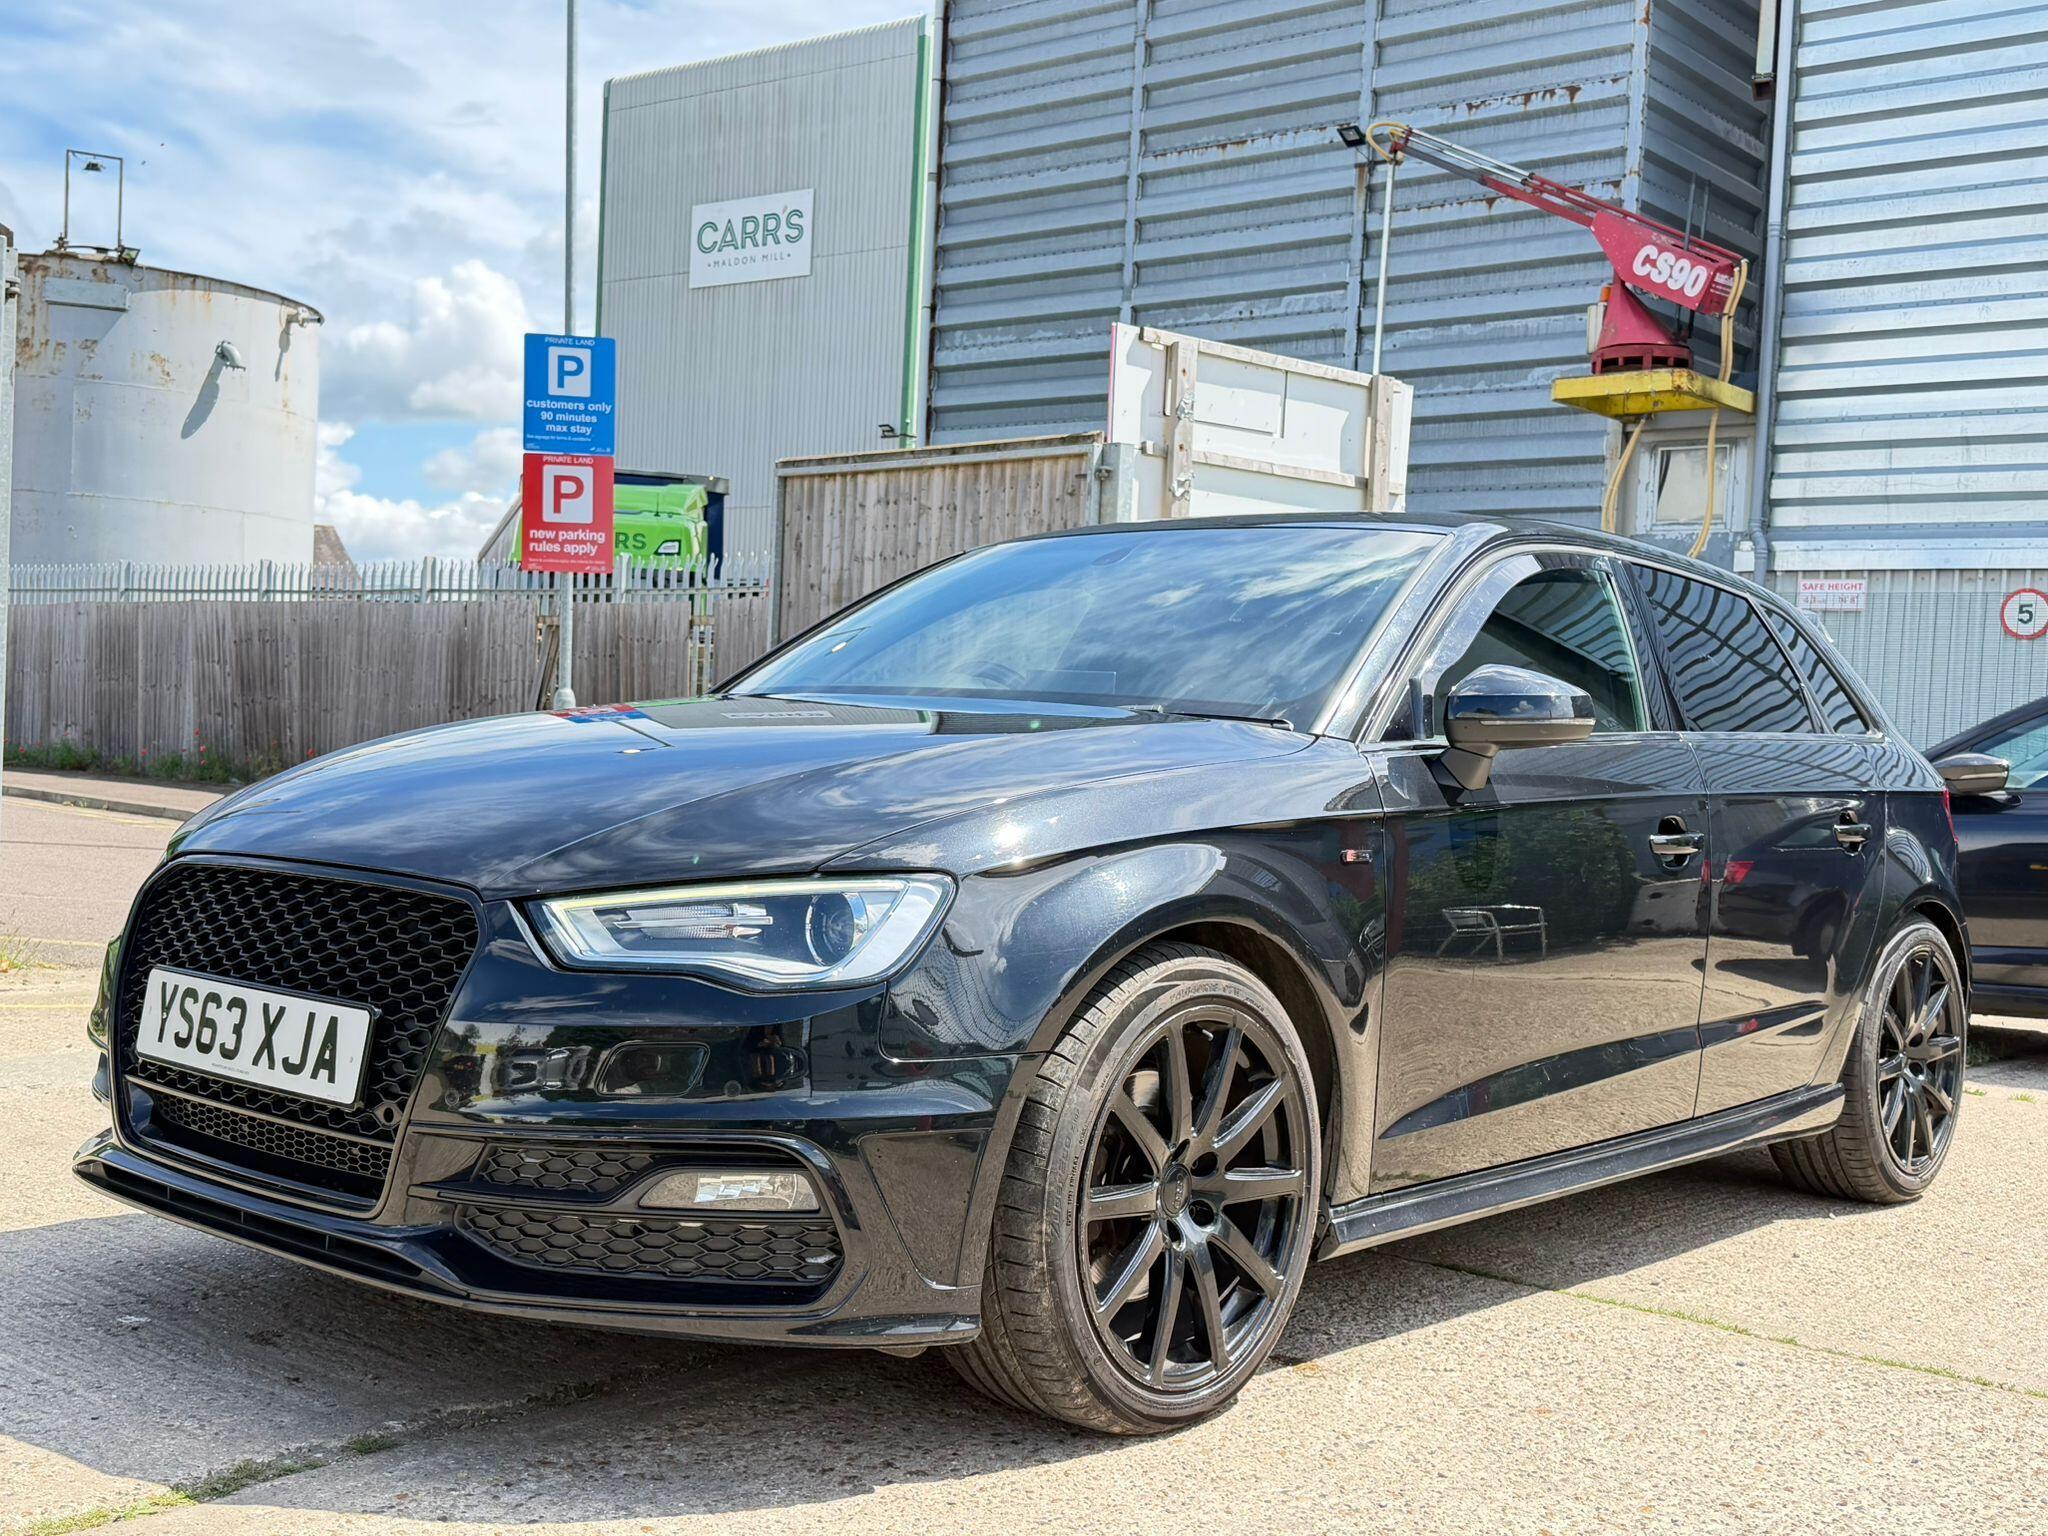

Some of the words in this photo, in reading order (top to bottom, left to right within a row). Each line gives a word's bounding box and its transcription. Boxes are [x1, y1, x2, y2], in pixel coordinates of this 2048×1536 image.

[697, 205, 804, 254] CARR'S
[713, 256, 757, 268] MALDON
[762, 252, 785, 263] MILL
[1632, 244, 1708, 297] CS90
[544, 336, 573, 345] PRIVATE
[575, 338, 596, 347] LAND
[557, 355, 584, 389] P
[526, 399, 585, 411] customers
[588, 402, 612, 414] only
[540, 411, 553, 421] 90
[556, 412, 598, 423] minutes
[546, 424, 568, 433] max
[570, 425, 592, 436] stay
[543, 455, 572, 464] PRIVATE
[573, 457, 594, 465] LAND
[553, 475, 584, 514] P
[529, 529, 556, 539] new
[558, 528, 606, 544] parking
[529, 541, 561, 552] rules
[563, 542, 598, 556] apply
[1801, 582, 1825, 591] SAFE
[1828, 582, 1864, 591] HEIGHT
[2017, 603, 2034, 625] 5
[157, 981, 248, 1061] YS63
[251, 1002, 339, 1084] XJA
